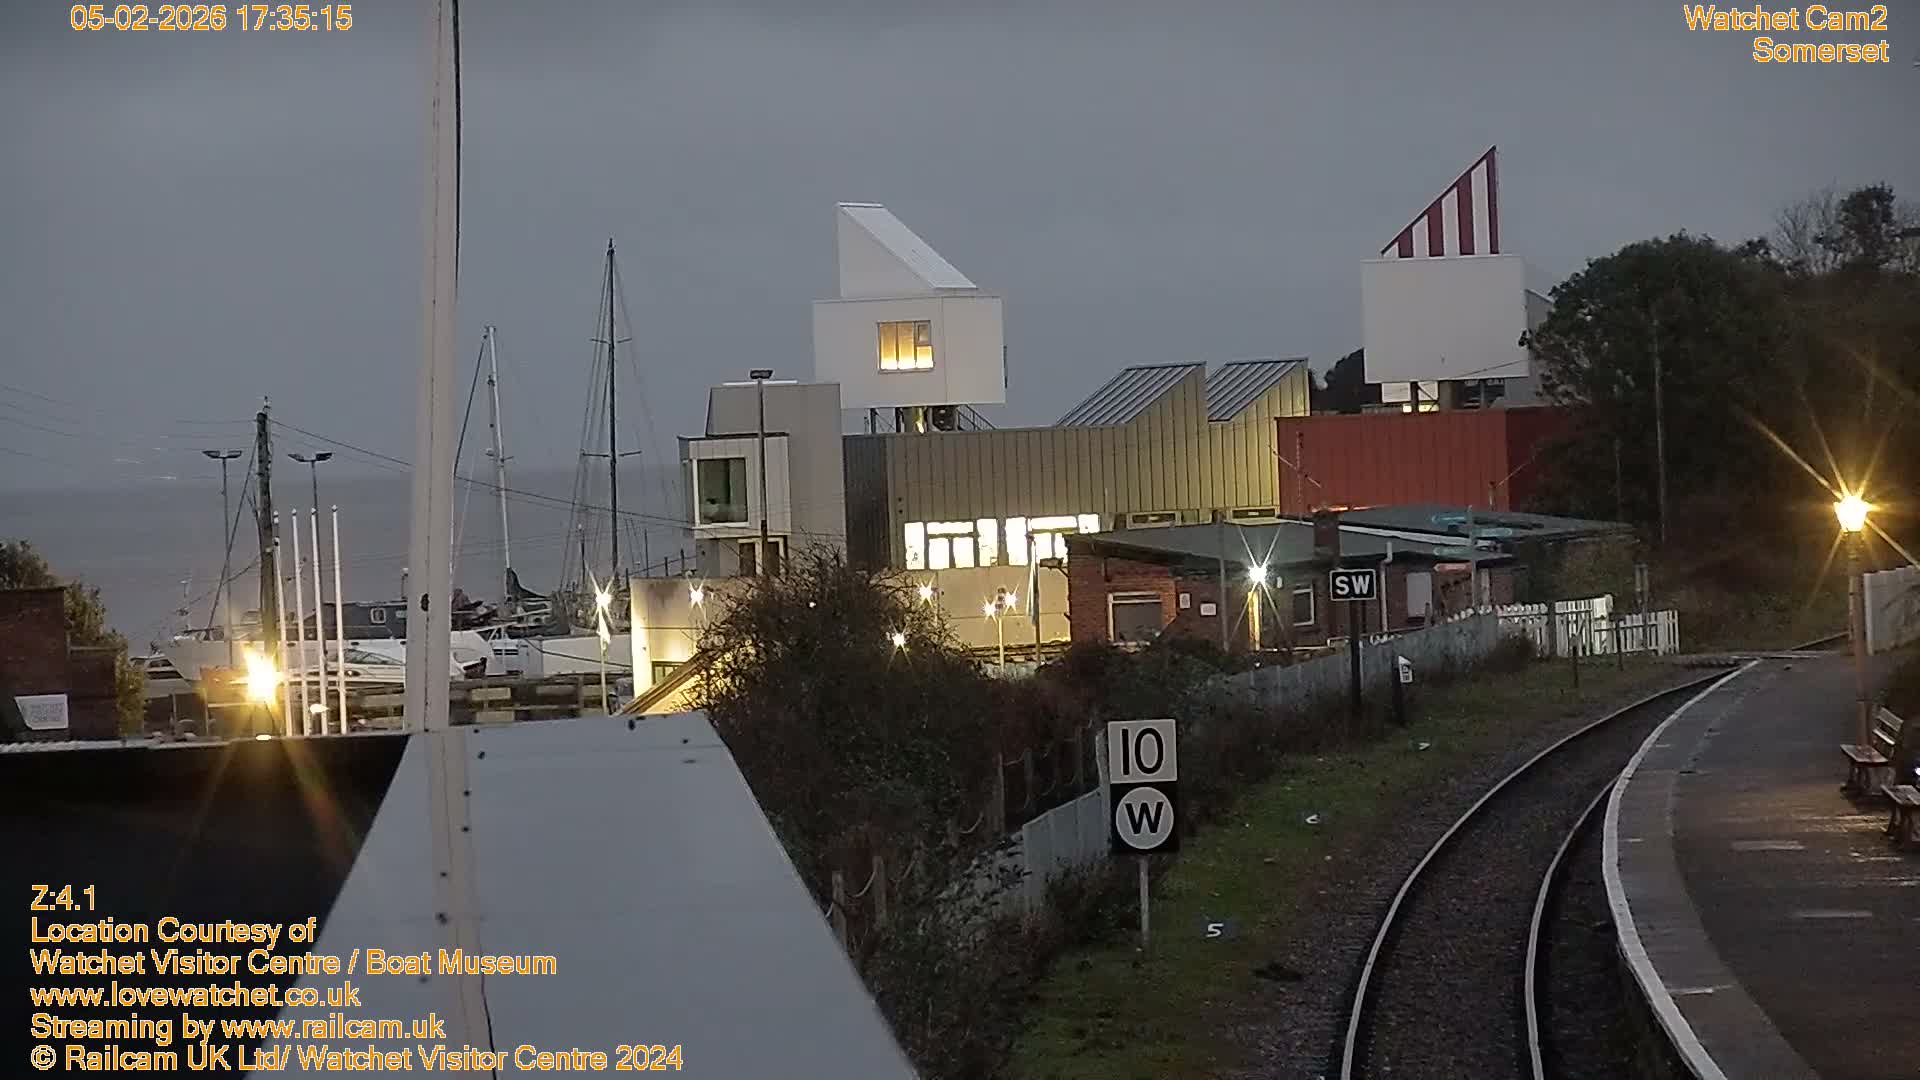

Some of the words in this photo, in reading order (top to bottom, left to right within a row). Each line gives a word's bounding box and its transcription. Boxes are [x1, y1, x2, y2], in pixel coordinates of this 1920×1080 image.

[1335, 574, 1370, 595] SW
[1121, 727, 1164, 775] 10
[1124, 801, 1164, 834] W
[1206, 923, 1224, 938] 5
